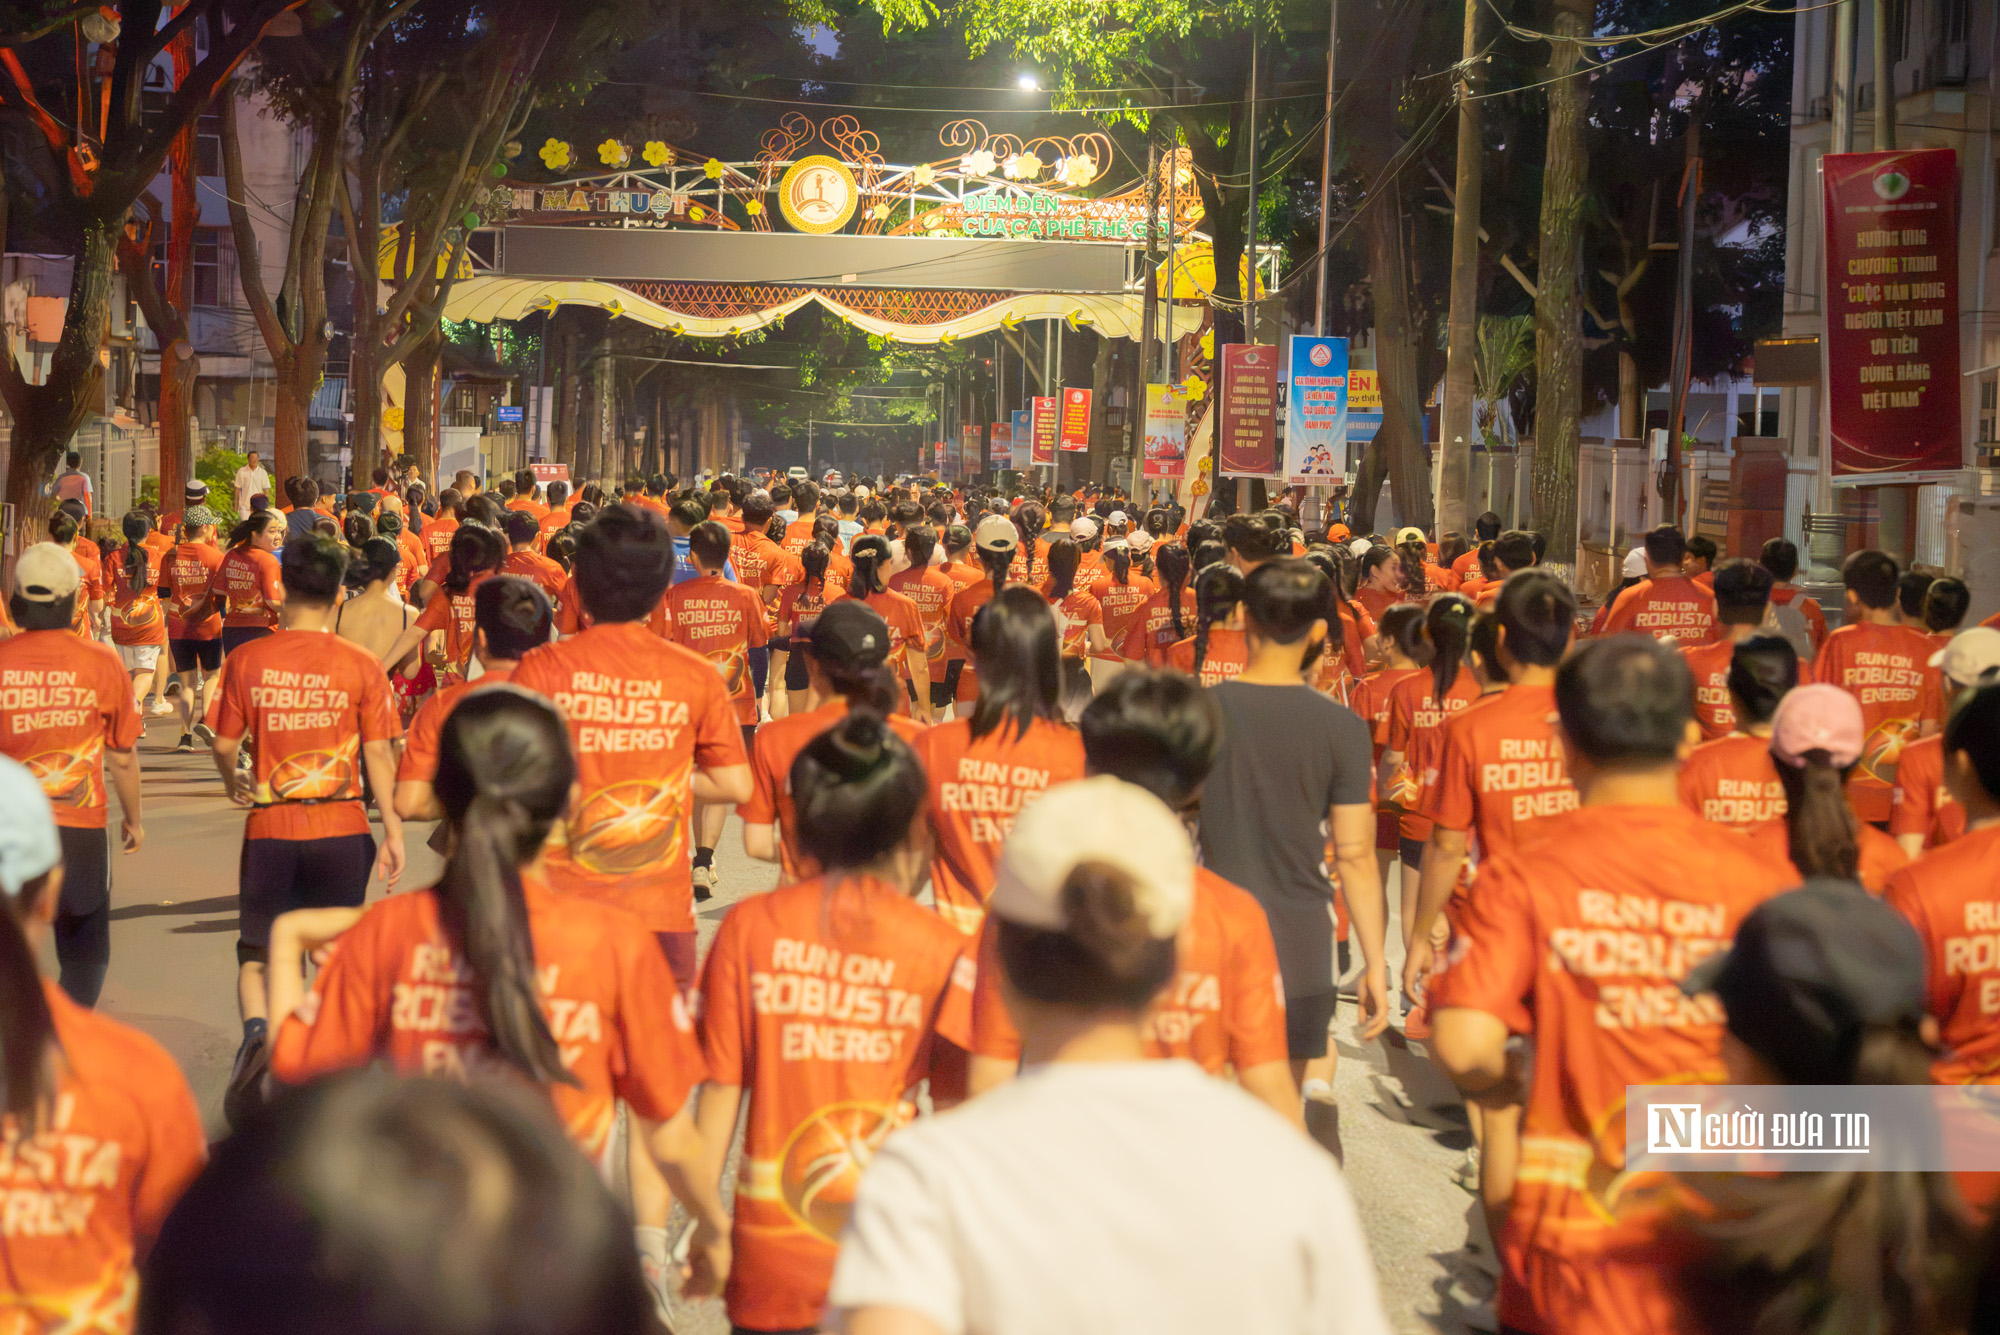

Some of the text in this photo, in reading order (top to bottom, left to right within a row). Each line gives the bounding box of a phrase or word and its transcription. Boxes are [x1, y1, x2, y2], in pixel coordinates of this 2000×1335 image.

[541, 190, 590, 211] MA
[963, 190, 1058, 212] ĐIỂM ĐẾN
[963, 214, 1007, 235] CỦA
[1011, 214, 1042, 236] CÀ
[1047, 216, 1086, 237] PHÊ
[1090, 215, 1128, 238] THẾ
[1885, 308, 1911, 330] VIỆT
[1914, 309, 1944, 326] NAM
[1862, 389, 1887, 412] VIỆT
[903, 582, 935, 593] RUN ON
[684, 599, 728, 610] RUN ON
[1648, 601, 1698, 612] RUN ON
[677, 610, 742, 625] ROBUSTA
[1636, 613, 1712, 627] ROBUSTA
[690, 624, 737, 639] ENERGY
[1223, 662, 1243, 673] ON
[1855, 651, 1913, 668] RUN ON
[2, 670, 77, 686] RUN ON
[262, 669, 330, 688] RUN ON
[572, 671, 662, 698] RUN ON
[1844, 666, 1924, 686] ROBUSTA
[250, 687, 349, 709] ROBUSTA
[1861, 686, 1918, 704] ENERGY
[553, 692, 689, 725] ROBUSTA
[12, 710, 90, 734] ENERGY
[267, 711, 341, 732] ENERGY
[579, 726, 679, 753] ENERGY
[1500, 739, 1547, 759] RUN
[958, 758, 1050, 789] RUN ON
[1718, 779, 1762, 798] RUN
[1704, 799, 1788, 822] ROBUS
[1578, 888, 1726, 936] RUN ON
[773, 938, 894, 983] RUN ON
[750, 972, 922, 1030] ROBUSTA
[782, 1023, 906, 1063] ENERGY
